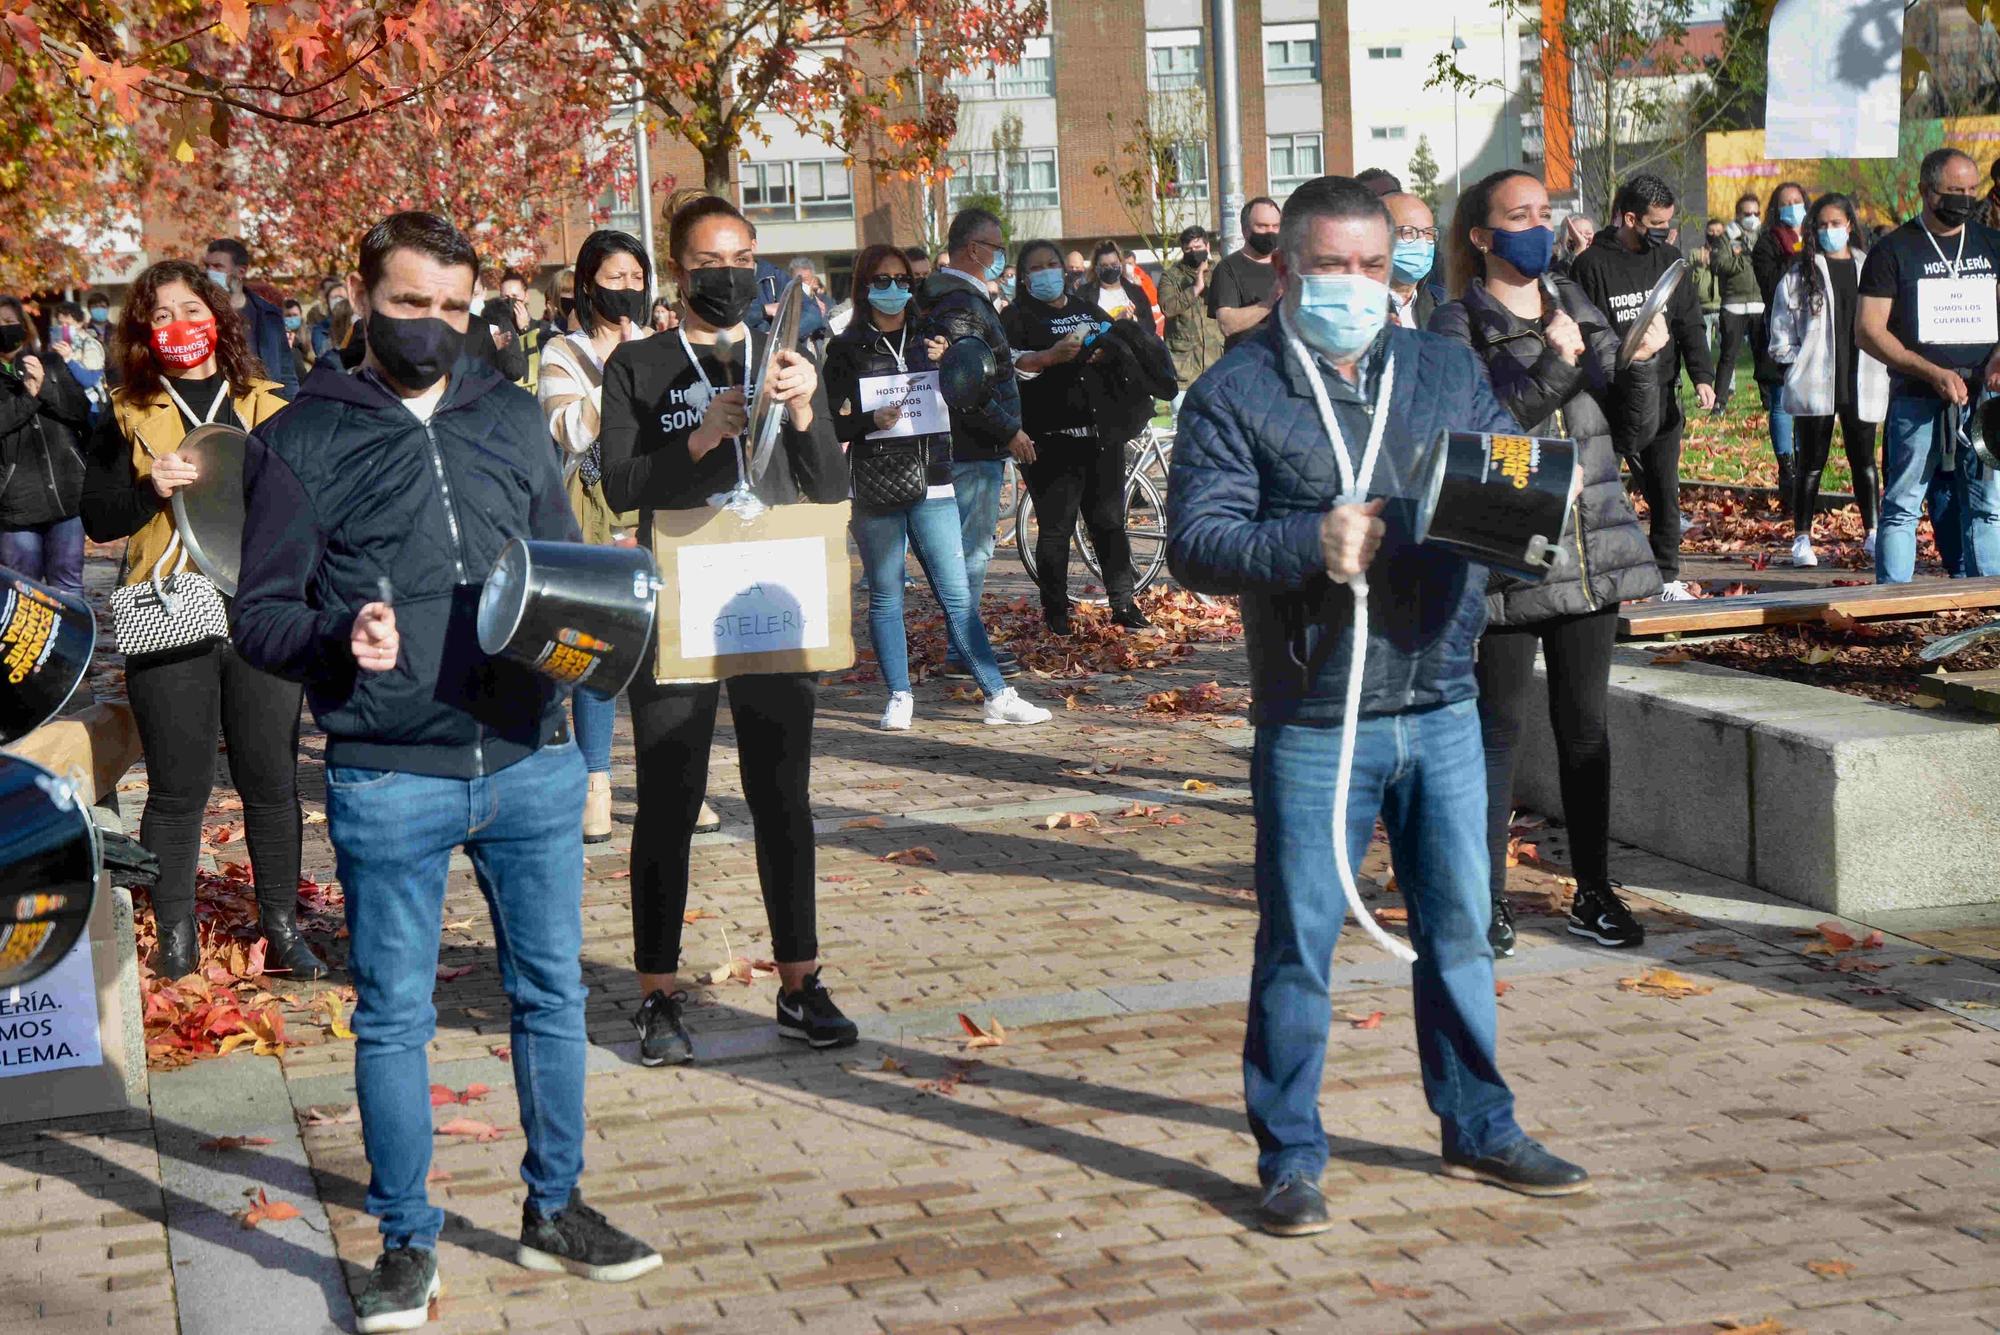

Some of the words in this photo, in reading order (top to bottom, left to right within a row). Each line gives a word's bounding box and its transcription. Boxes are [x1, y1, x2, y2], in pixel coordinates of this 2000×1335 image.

[1924, 255, 1992, 275] HOSTLERÍA
[1609, 292, 1644, 309] TOD@S
[1051, 324, 1079, 334] SOMO
[1933, 316, 1982, 324] CULPABLES
[660, 409, 705, 433] SOM
[0, 991, 63, 1018] ERÍA.
[0, 1018, 53, 1041] MOS
[0, 1042, 80, 1067] LEMA.
